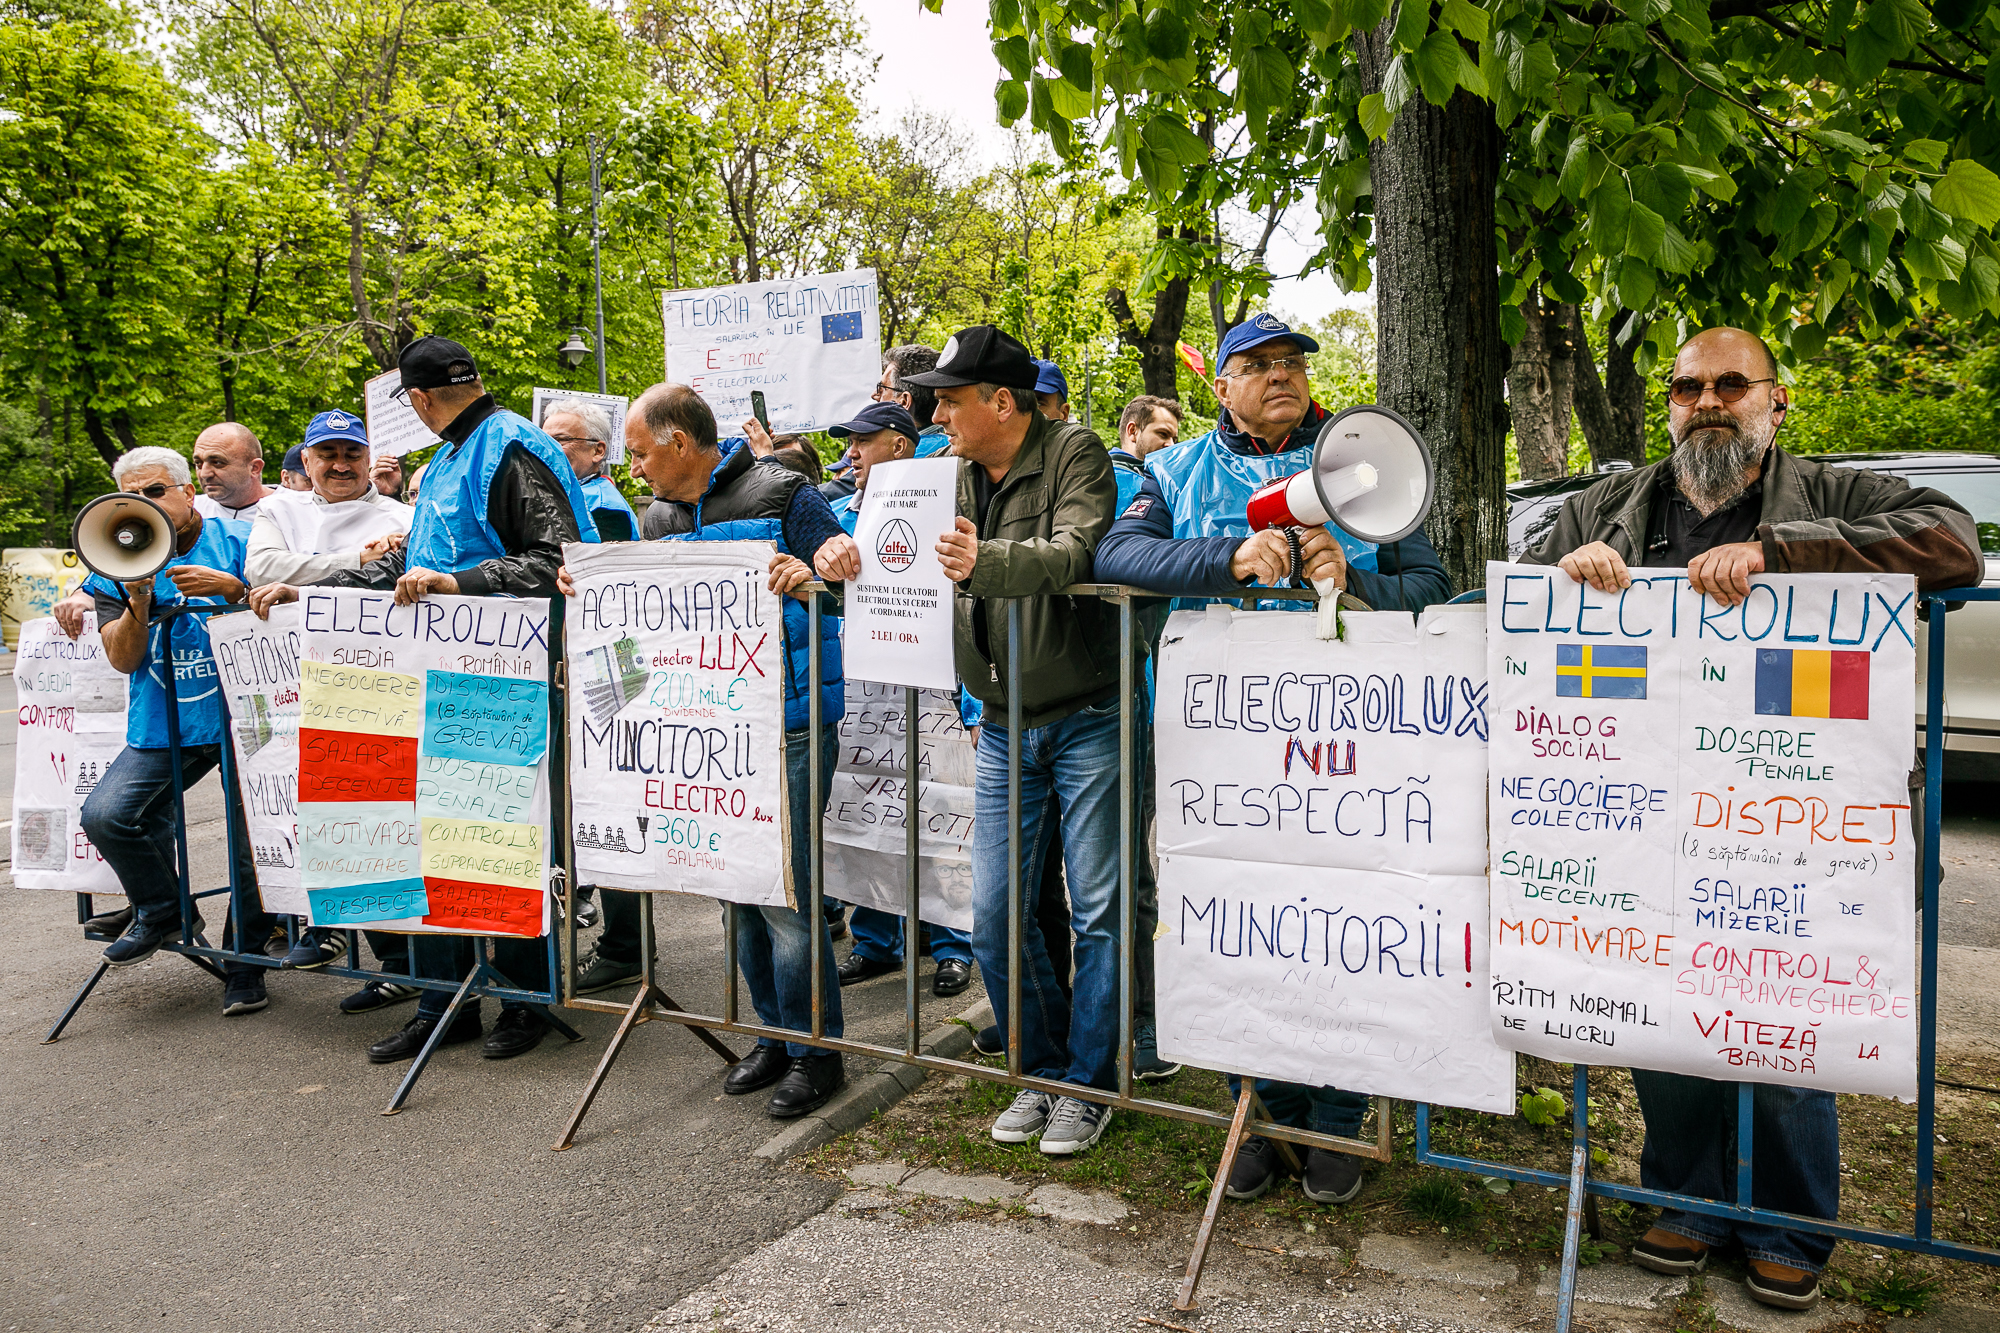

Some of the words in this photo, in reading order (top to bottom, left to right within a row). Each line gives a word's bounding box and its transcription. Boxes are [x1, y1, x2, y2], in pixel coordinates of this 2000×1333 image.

[669, 292, 749, 327] TEORIA
[784, 321, 806, 335] UE
[706, 348, 720, 369] E
[717, 373, 788, 388] ELECTROLUX
[894, 489, 938, 497] ELECTROLUX
[881, 556, 911, 564] CARTEL
[885, 541, 907, 553] alfa
[857, 584, 889, 594] SUSTINEM
[892, 586, 938, 597] LUCRATORII
[857, 595, 902, 606] ELECTROLUX
[902, 598, 910, 607] SI
[911, 599, 937, 609] CEREM
[305, 595, 549, 651] ELECTROLUX
[869, 607, 912, 618] ACORDAREA
[1501, 574, 1915, 652] ELECTROLUX
[46, 619, 94, 636] POLCA
[871, 630, 876, 640] 2
[877, 630, 892, 641] LEI
[899, 632, 919, 644] ORA
[22, 641, 101, 660] ELECTROLUX:
[331, 646, 394, 668] SUEDIA
[457, 652, 532, 675] ROMÂNIA
[652, 648, 693, 667] electro
[699, 632, 768, 678] LUX
[174, 663, 217, 680] RTEL
[1505, 655, 1527, 676] ÎN
[1702, 657, 1726, 682] ÎN
[38, 671, 72, 692] SUEDIA
[307, 665, 419, 697] NEGOCIERE
[650, 671, 694, 708] 200
[274, 686, 299, 707] electro
[1184, 671, 1489, 743] ELECTROLUX
[19, 704, 75, 733] CONFORT
[274, 711, 297, 736] 200
[437, 702, 456, 720] (8
[662, 705, 716, 718] DIVIDENDE
[1515, 706, 1617, 737] DIALOG
[304, 737, 406, 769] SALARII
[1532, 738, 1621, 762] SOCIAL
[1695, 726, 1816, 758] DOSARE
[1284, 734, 1357, 780] NU
[1735, 757, 1835, 782] PENALE
[304, 771, 413, 794] DECENTE
[425, 756, 534, 799] DOSARE
[416, 779, 521, 822] PENALE
[644, 779, 746, 818] ELECTRO
[752, 806, 774, 824] lux
[1501, 775, 1668, 811] NEGOCIERE
[306, 816, 418, 846] MOTIVARE
[654, 815, 700, 848] 360
[709, 832, 722, 852] €
[1511, 809, 1643, 832] COLECTIVĂ
[428, 823, 527, 848] CONTROL
[528, 825, 538, 850] &
[307, 857, 409, 874] CONSULTARE
[429, 854, 542, 879] SUPRAVEGHERE
[667, 848, 726, 871] SALARIU
[1500, 851, 1596, 887] SALARII
[1794, 851, 1807, 866] de
[320, 888, 425, 916] RESPECT
[432, 885, 509, 906] SALARII
[518, 898, 531, 910] de
[1521, 882, 1640, 911] DECENTE
[1689, 877, 1806, 914] SALARII
[1839, 901, 1865, 916] DE
[442, 905, 511, 923] MIZERIE
[1696, 906, 1812, 938] MIZERIE
[1181, 895, 1444, 979] MUNCITORII
[1499, 915, 1676, 966] MOTIVARE
[1692, 941, 1851, 985] CONTROL
[1856, 955, 1879, 989] &
[1493, 980, 1555, 1009] RITM
[1570, 993, 1660, 1026] NORMAL
[1676, 970, 1911, 1018] SUPRAVEGHERE
[1186, 1014, 1449, 1073] ELECTROLUX
[1500, 1015, 1527, 1030] DE
[1544, 1020, 1615, 1046] LUCRU
[1693, 1010, 1821, 1052] VITEZĂ
[1858, 1043, 1879, 1060] LA
